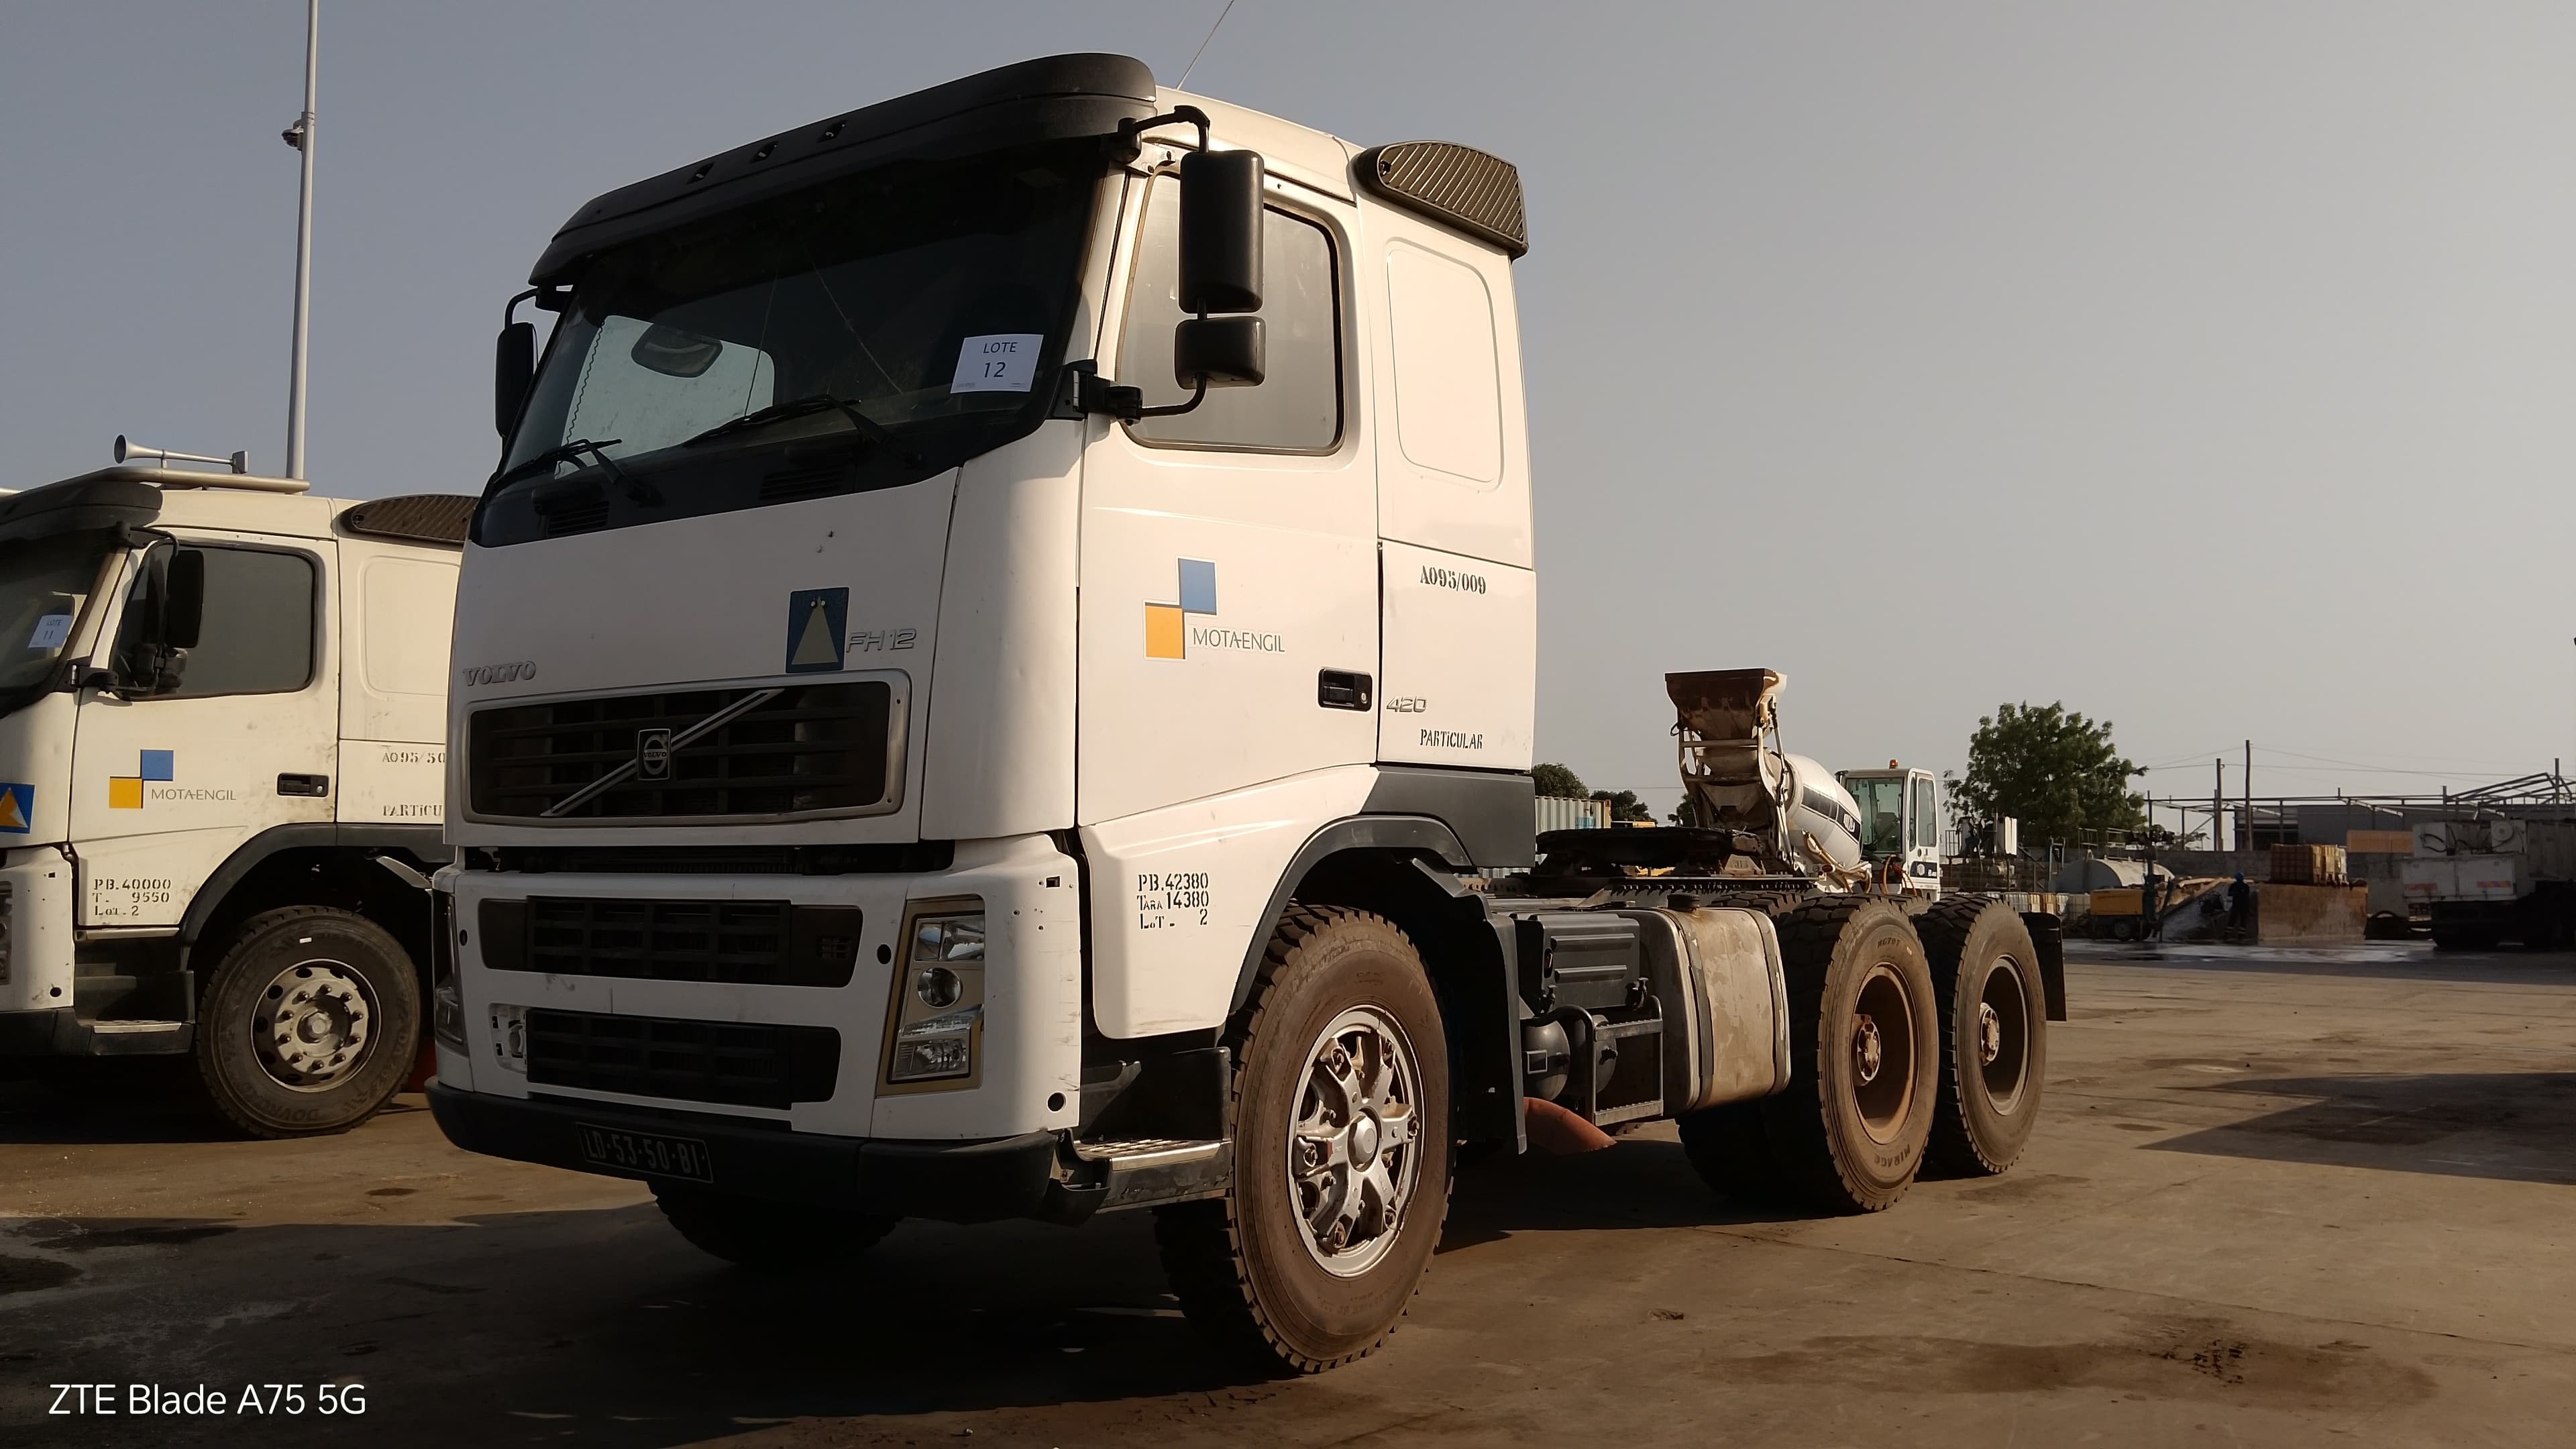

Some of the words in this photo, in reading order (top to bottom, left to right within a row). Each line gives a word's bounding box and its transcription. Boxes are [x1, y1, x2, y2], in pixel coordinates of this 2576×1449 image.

[983, 341, 1018, 354] LOTE
[983, 362, 1006, 378] 12
[1419, 565, 1487, 595] A095/009
[42, 630, 54, 640] 11
[462, 660, 537, 687] VOLVO
[1386, 695, 1427, 713] 420
[131, 892, 170, 903] 9550
[1166, 890, 1210, 910] 14380
[131, 905, 140, 916] 2
[1199, 908, 1208, 926] 2
